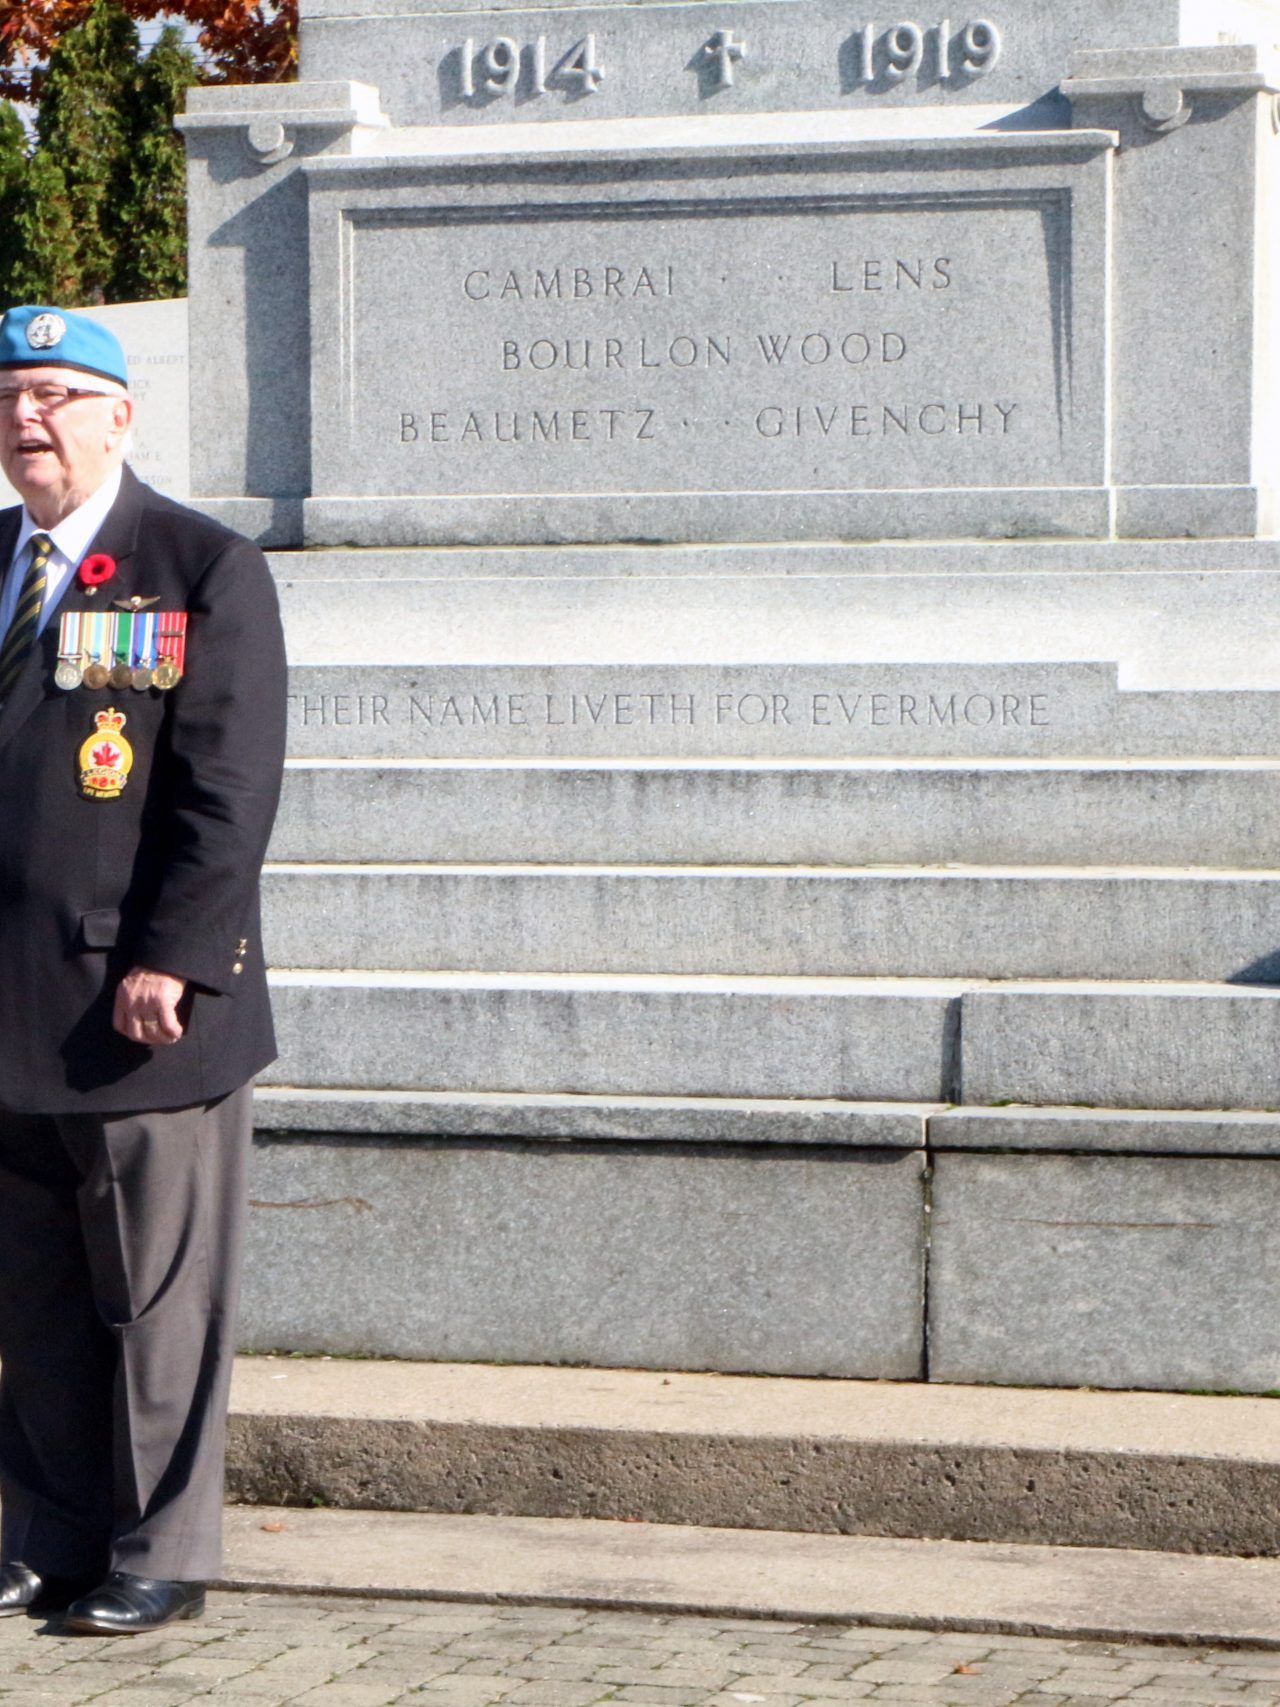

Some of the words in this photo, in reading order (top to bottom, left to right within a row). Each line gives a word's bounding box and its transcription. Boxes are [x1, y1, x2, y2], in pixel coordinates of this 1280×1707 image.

[462, 33, 605, 97] 1914
[860, 17, 1001, 81] 1919
[464, 266, 673, 300] CAMBRAI
[832, 257, 951, 291] LENS
[502, 336, 731, 370] BOURLON
[757, 333, 907, 364] WOOD
[400, 409, 655, 442] BEAUMETZ
[756, 403, 1017, 437] GIVENCHY
[410, 694, 527, 726] NAME
[545, 694, 695, 725] LIVETH
[716, 693, 791, 726] FOR
[812, 693, 1051, 726] EVERMORE
